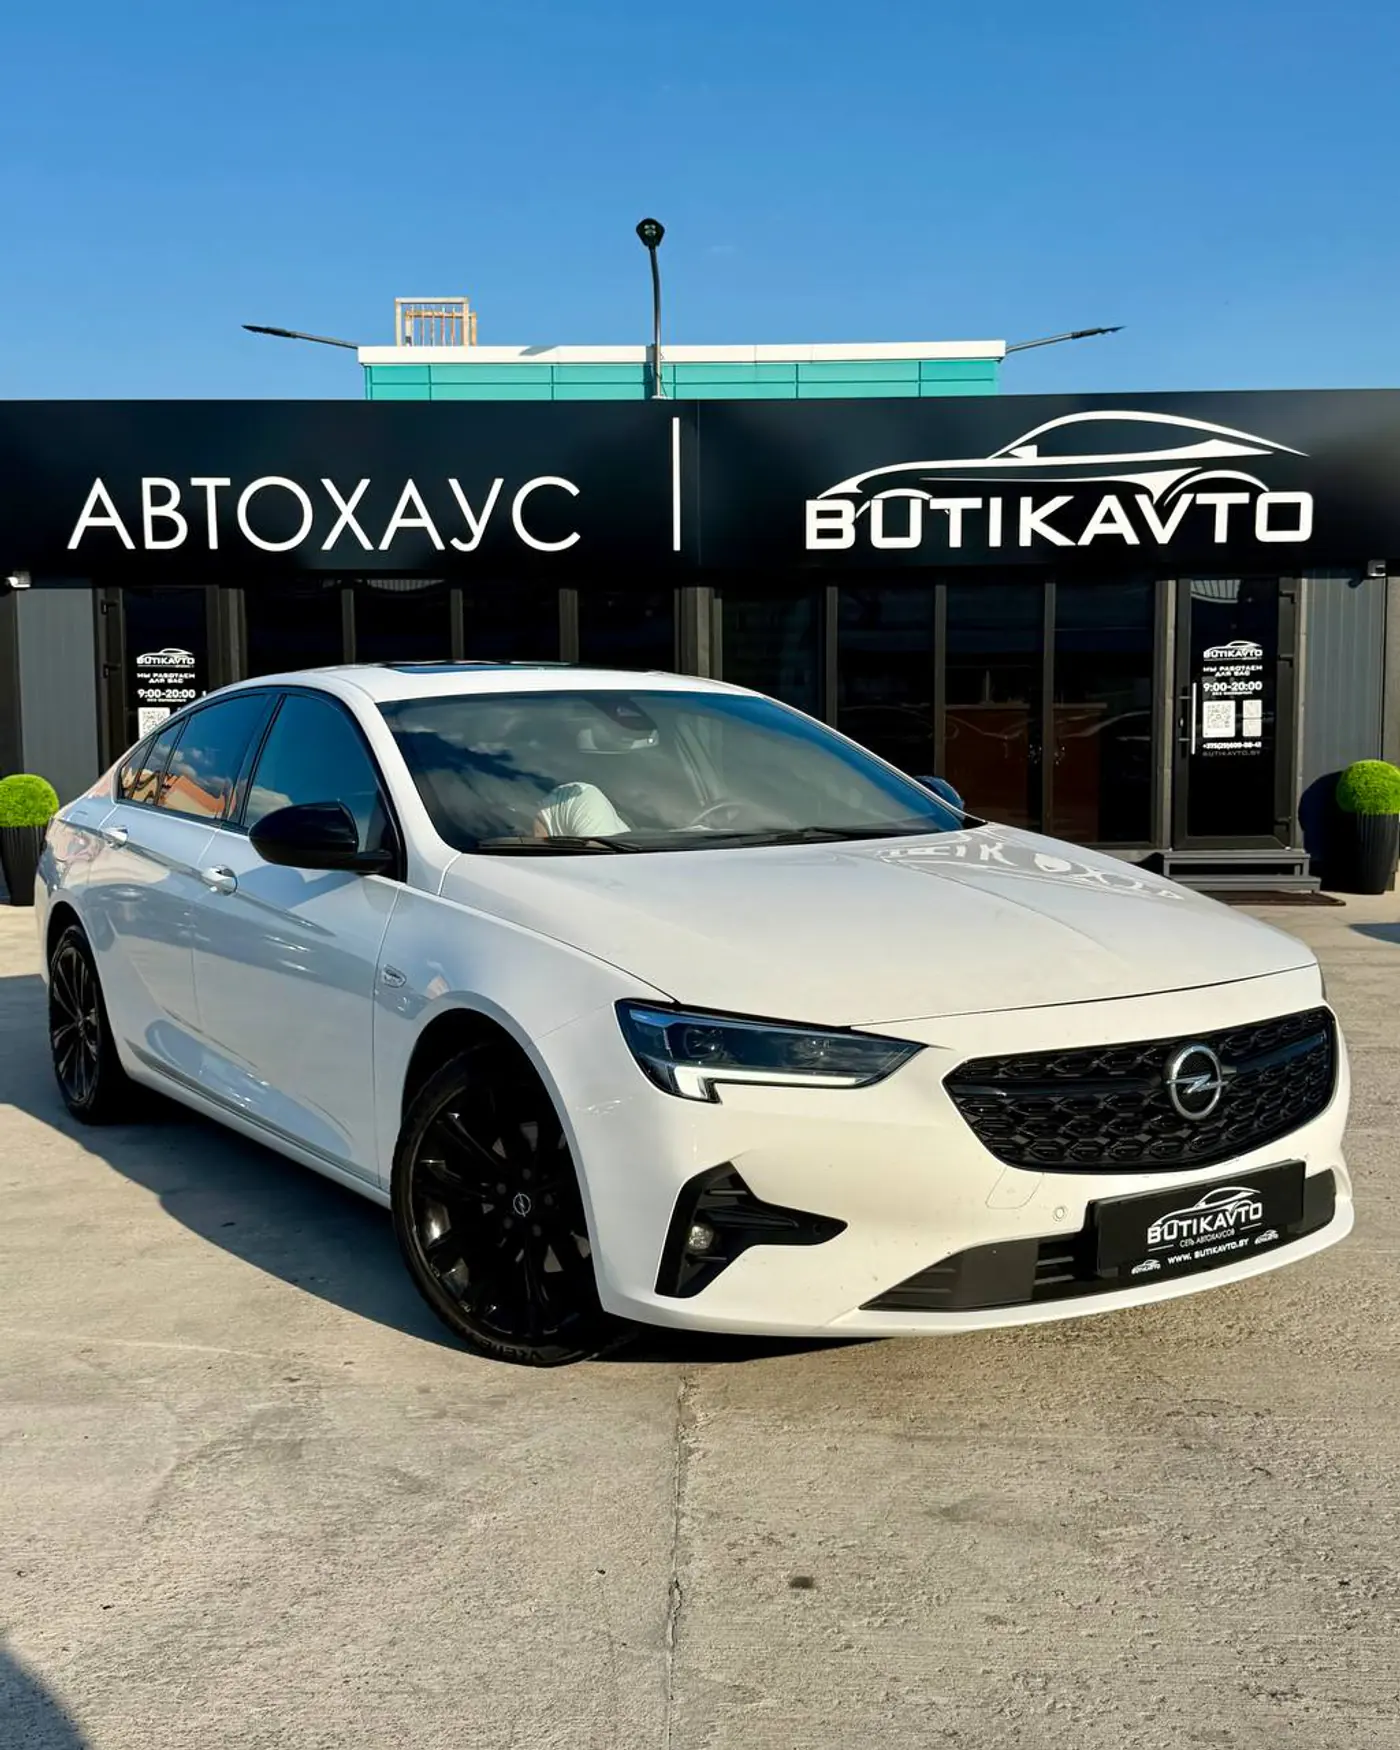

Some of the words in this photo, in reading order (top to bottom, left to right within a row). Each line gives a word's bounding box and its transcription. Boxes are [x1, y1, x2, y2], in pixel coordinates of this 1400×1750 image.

[66, 476, 581, 552] АВТОХАУС
[805, 490, 1314, 550] BUTIKAVTO
[1203, 649, 1263, 658] BUTIKAVTO
[136, 656, 195, 665] BUTIKAVTO
[1203, 681, 1263, 692] 9:00-20:00
[137, 688, 196, 699] 9:00-20:00
[1147, 1202, 1263, 1244] BUTIKAVTO
